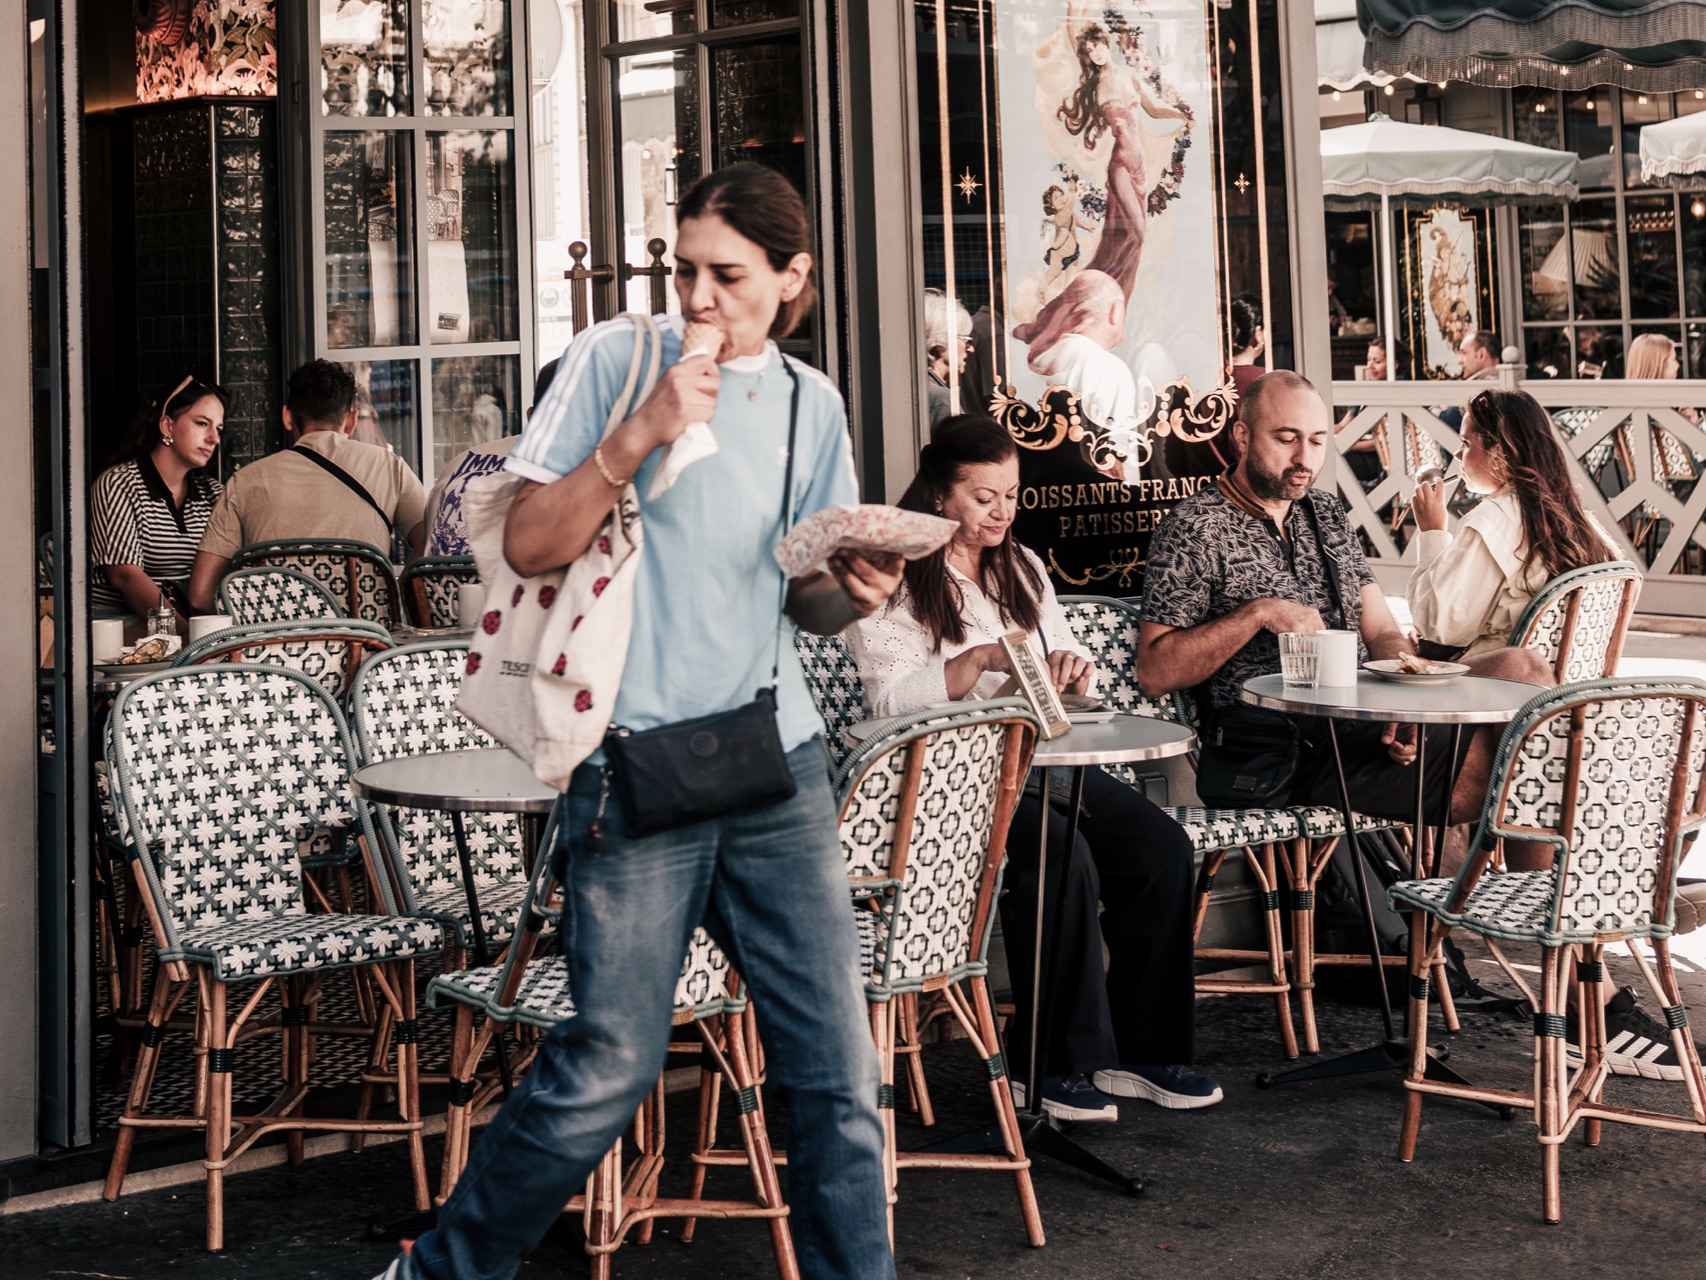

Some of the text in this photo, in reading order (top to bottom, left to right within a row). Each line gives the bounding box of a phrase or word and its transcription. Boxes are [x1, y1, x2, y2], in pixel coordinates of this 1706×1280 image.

[446, 450, 508, 485] IMM
[1016, 480, 1132, 510] OISSANTS
[1059, 508, 1171, 539] PATISSER
